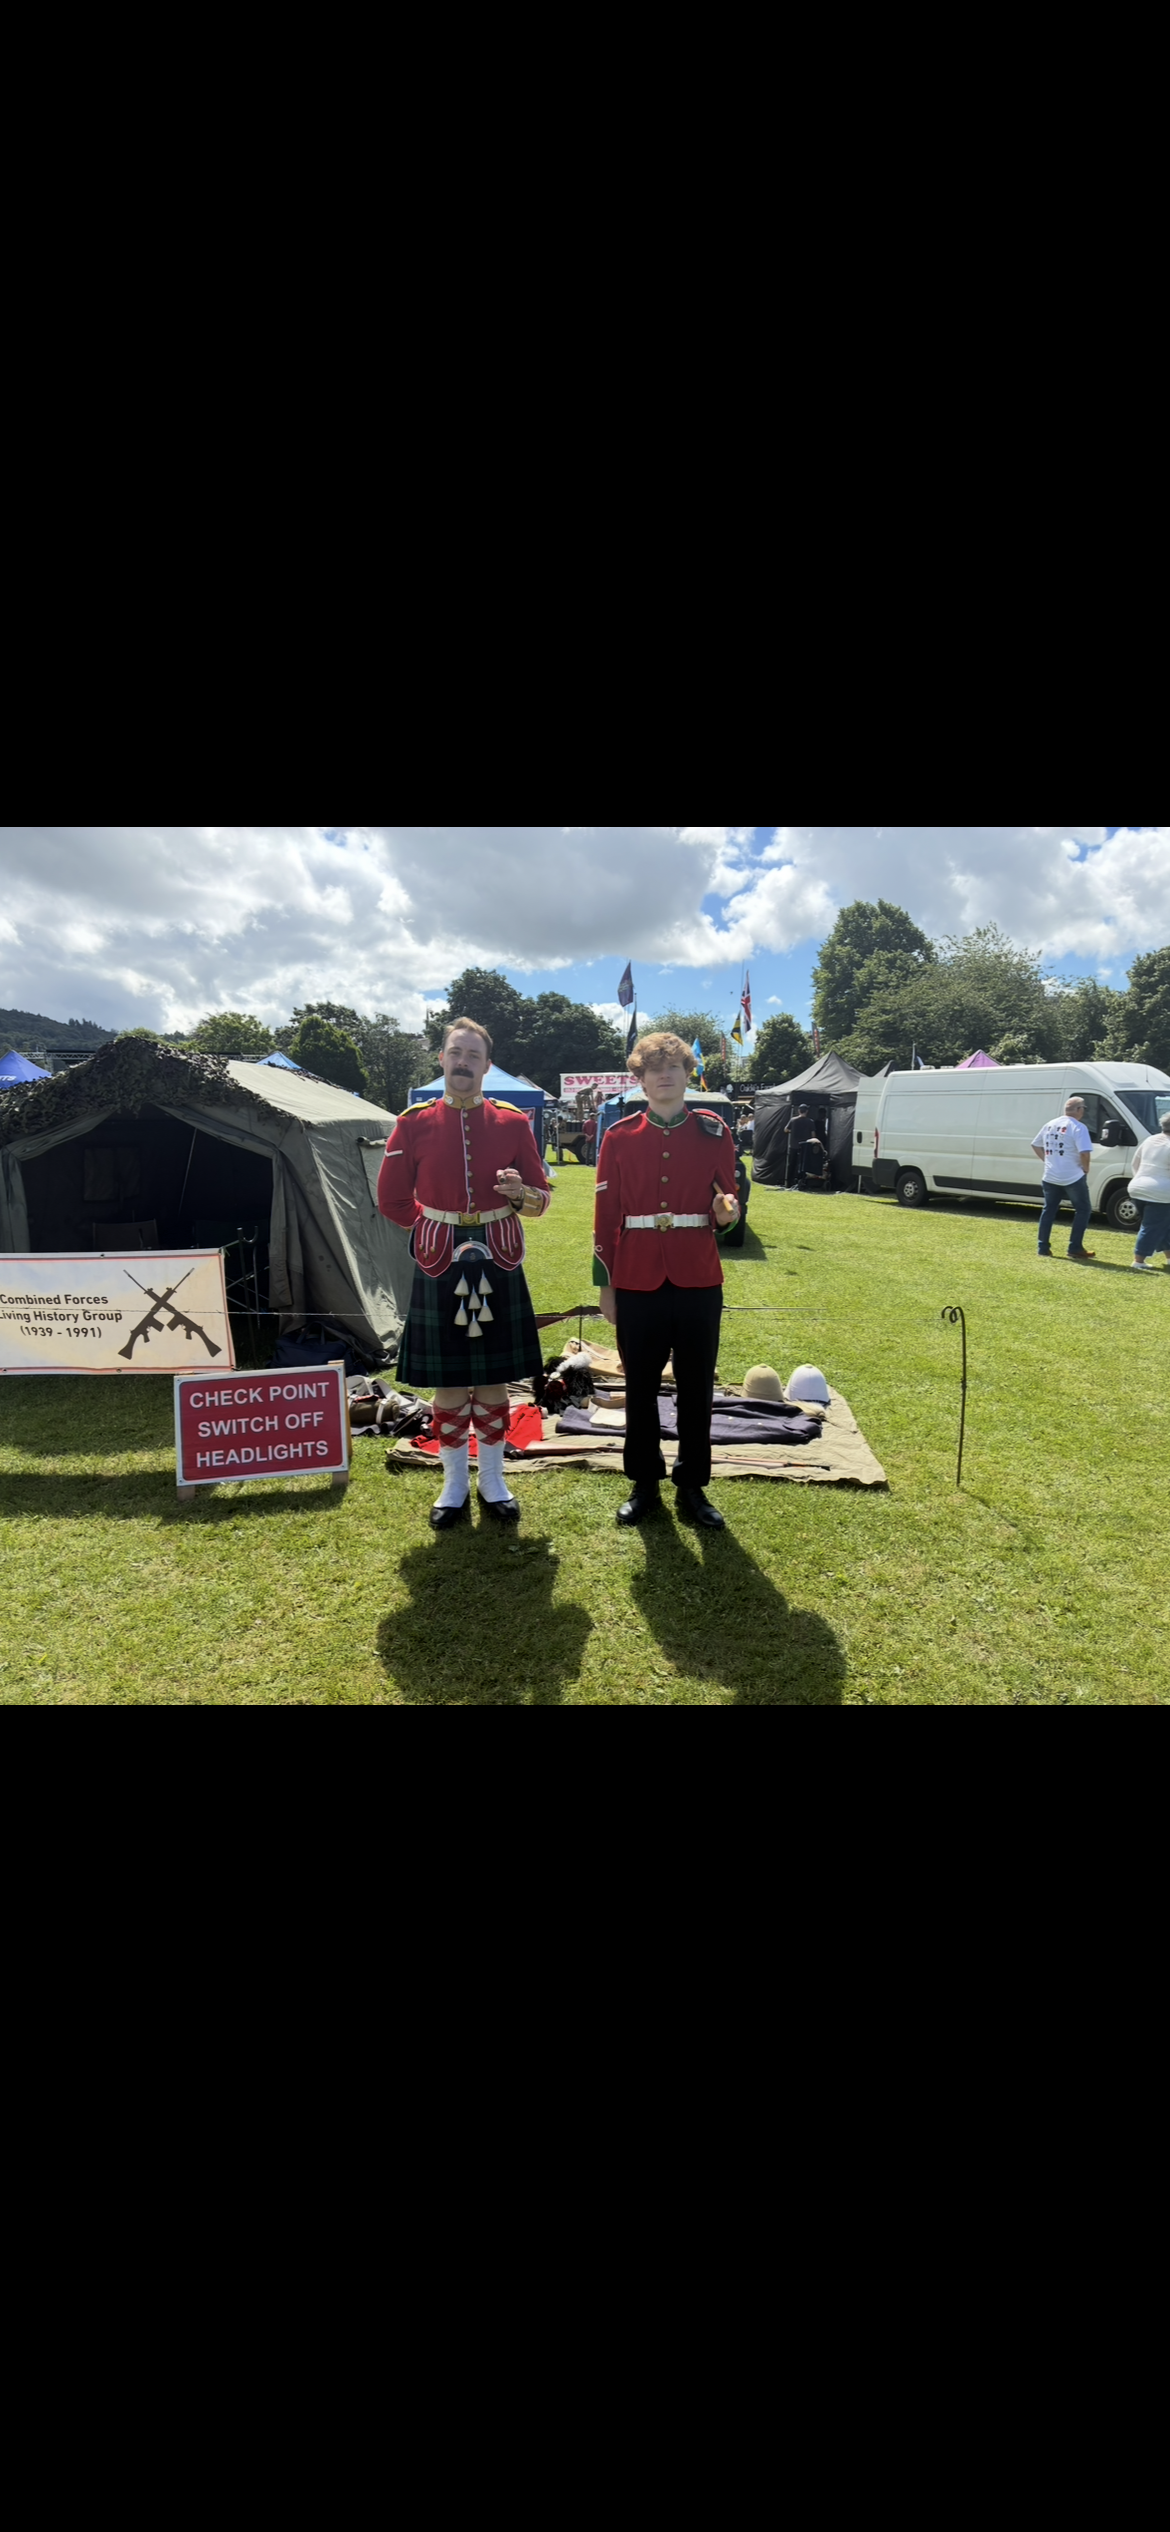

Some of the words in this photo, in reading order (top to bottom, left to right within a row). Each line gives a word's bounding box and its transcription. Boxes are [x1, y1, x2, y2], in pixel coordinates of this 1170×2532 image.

[564, 1075, 640, 1086] SWEETS
[0, 1293, 61, 1305] Combined
[64, 1294, 109, 1305] Forces
[33, 1310, 79, 1324] History
[82, 1310, 123, 1323] Group
[20, 1325, 53, 1337] (1939
[66, 1326, 102, 1339] 1991)
[189, 1387, 264, 1409] CHECK
[269, 1382, 330, 1402] POINT
[197, 1415, 279, 1438] SWITCH
[284, 1411, 324, 1430] OFF
[196, 1440, 329, 1468] HEADLIGHTS
